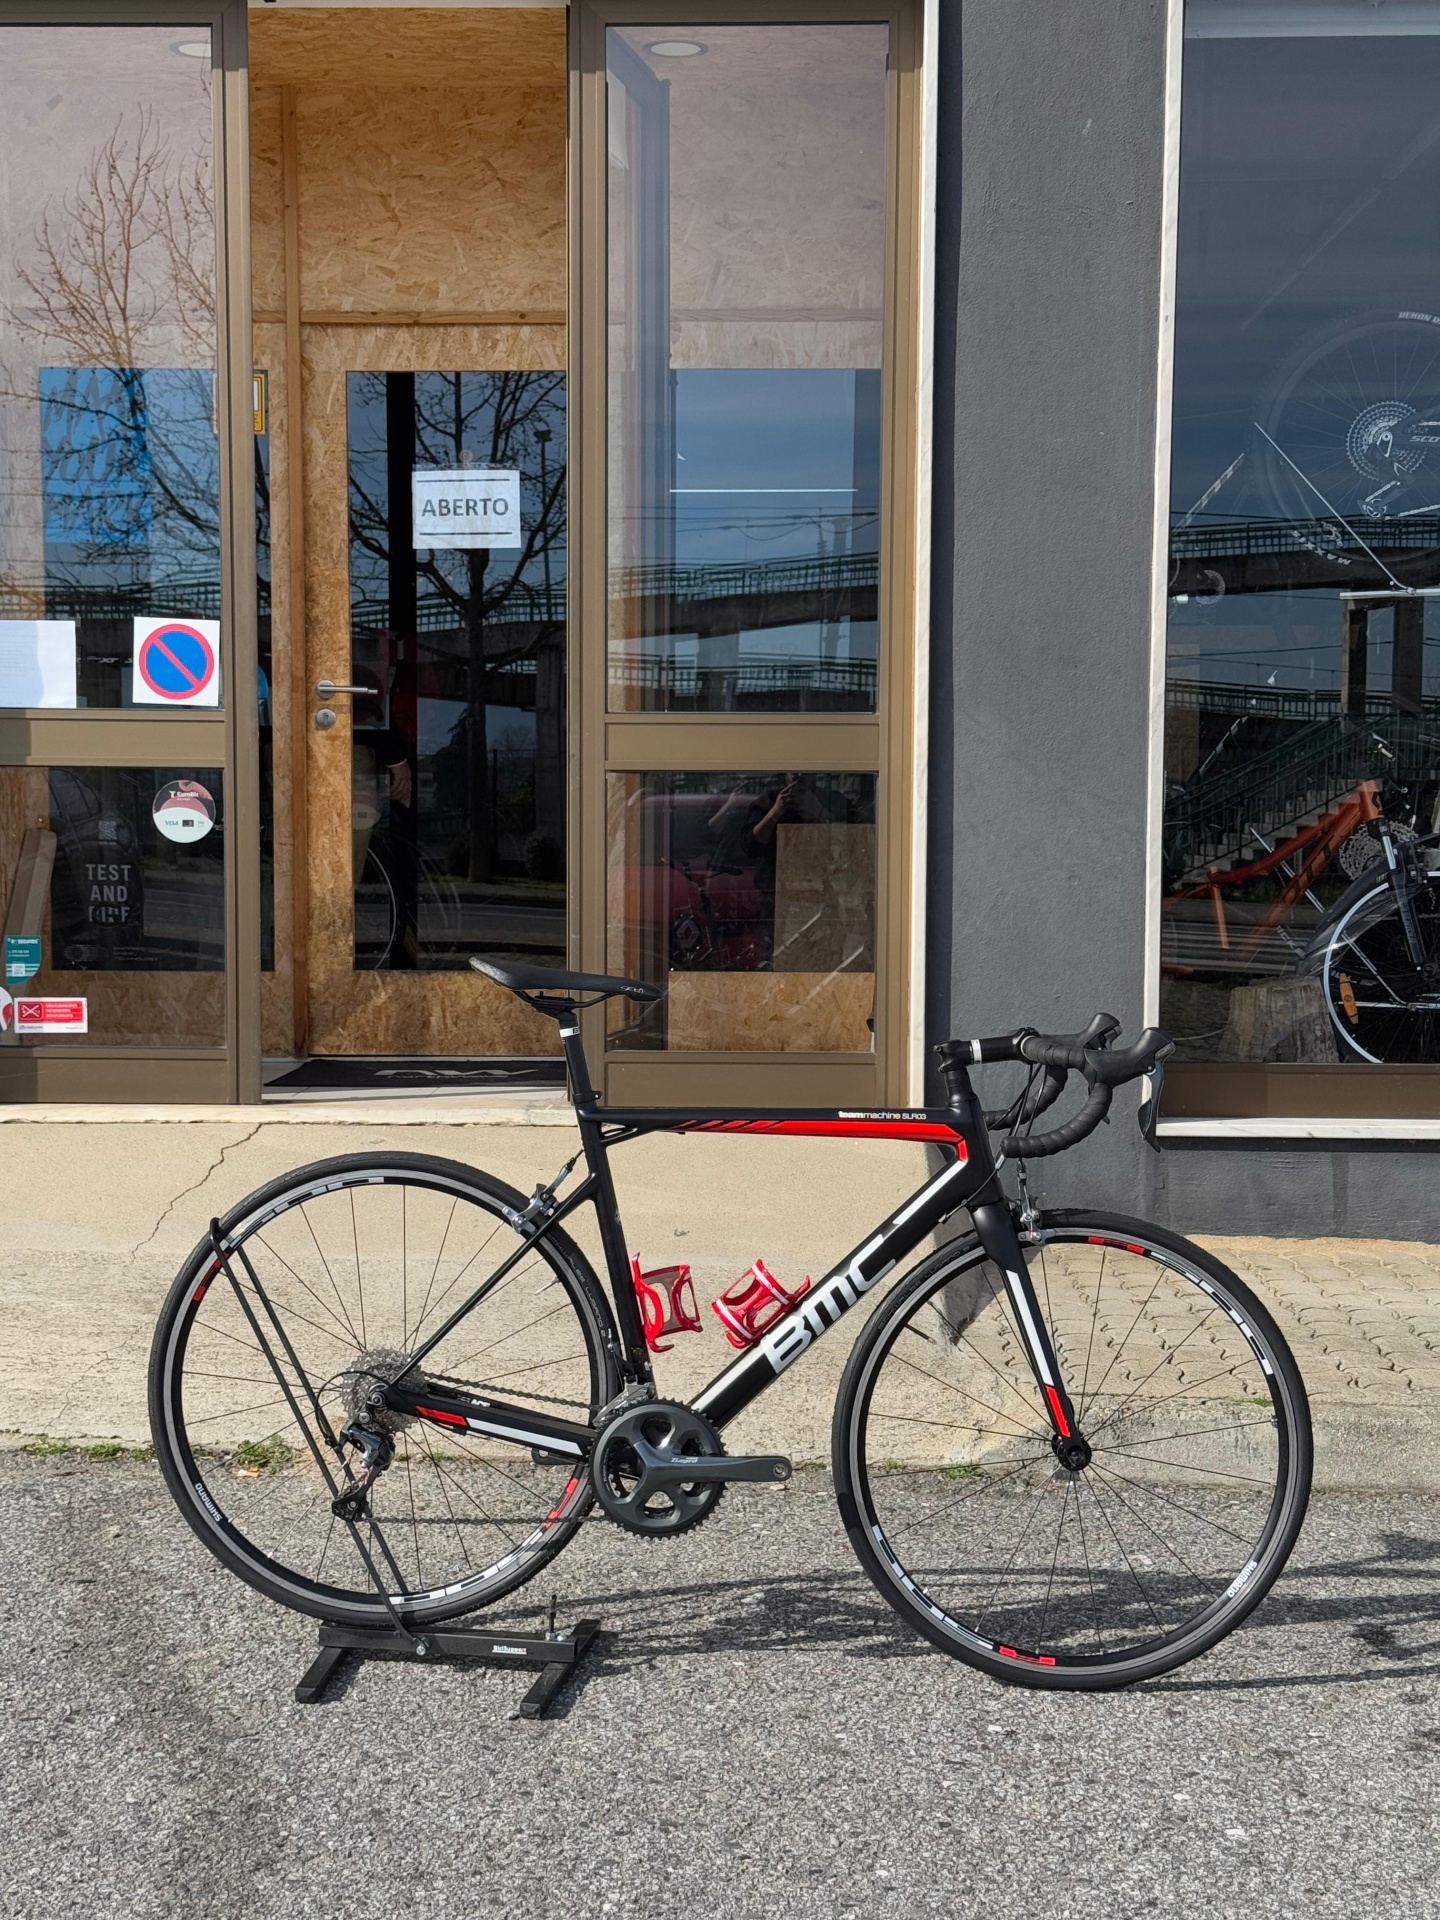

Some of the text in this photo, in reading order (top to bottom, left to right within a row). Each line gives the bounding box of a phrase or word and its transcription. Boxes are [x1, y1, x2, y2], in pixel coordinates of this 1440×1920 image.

[421, 498, 509, 517] ABERTO
[1291, 530, 1352, 565] MAXXIS
[85, 863, 131, 881] TEST
[90, 885, 128, 902] AND
[838, 1110, 927, 1120] teammachine SLR03
[760, 1233, 897, 1375] BMC
[195, 1482, 223, 1522] SHIMANO
[1226, 1560, 1258, 1598] SHIMANO
